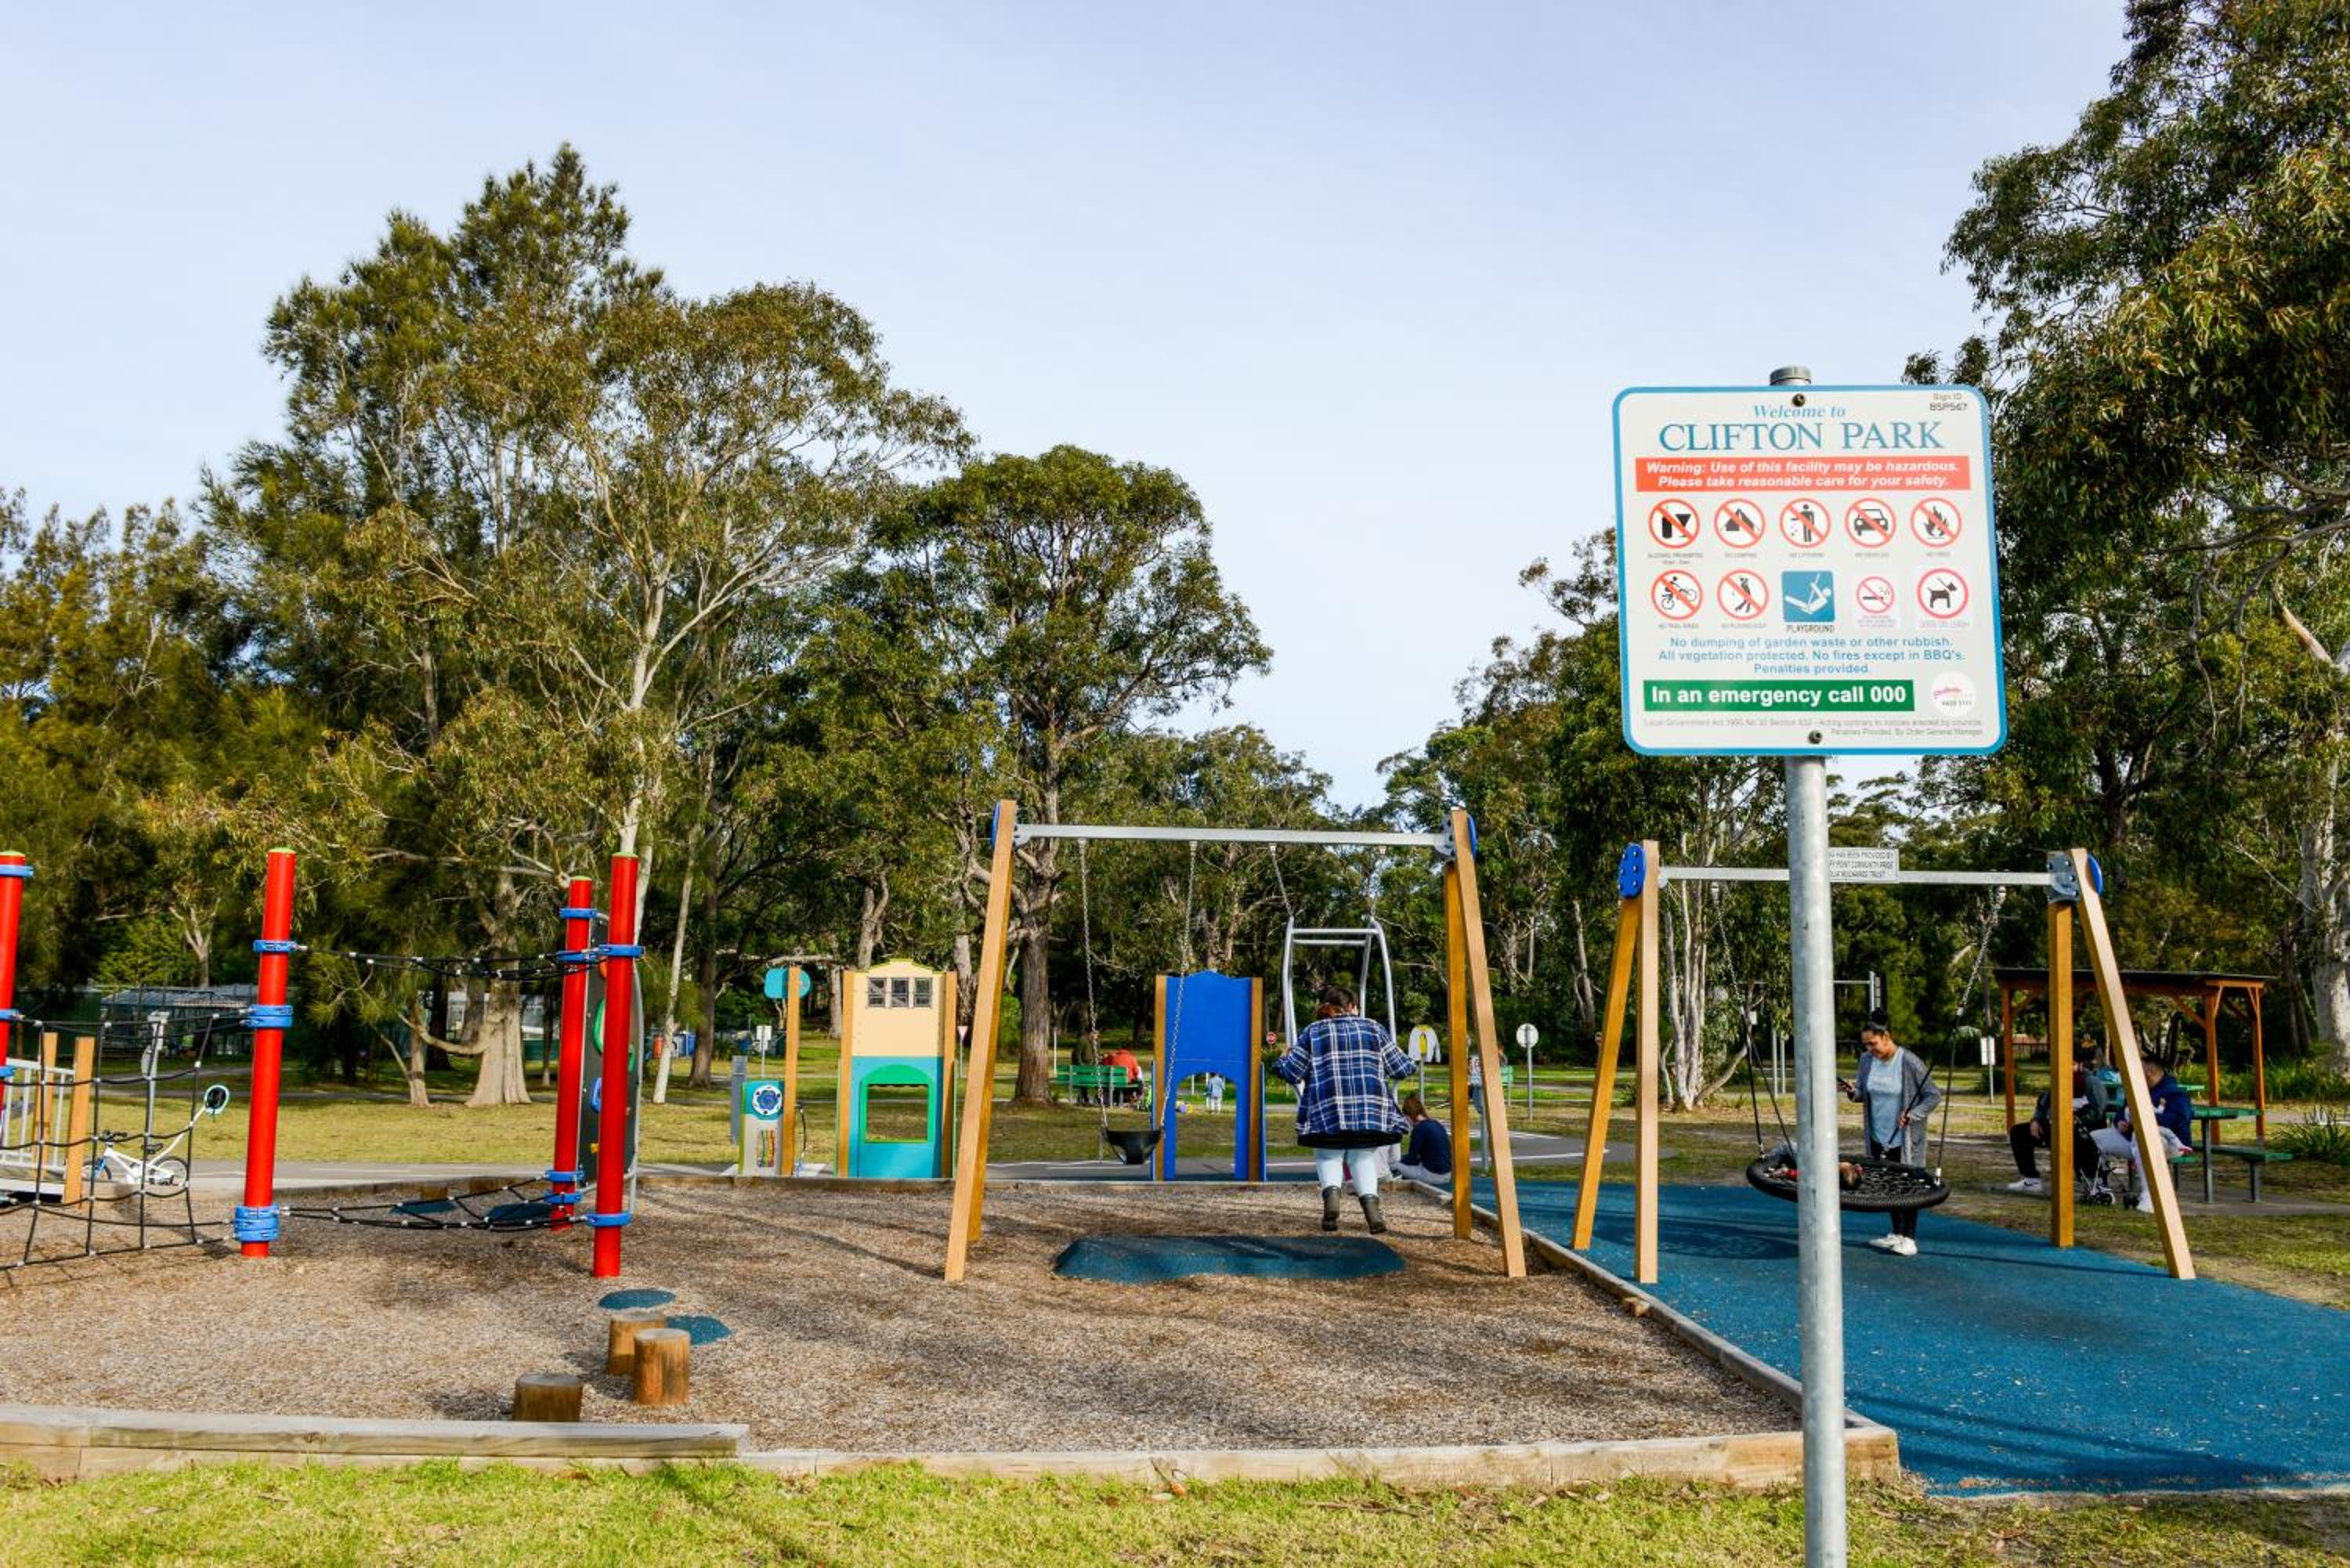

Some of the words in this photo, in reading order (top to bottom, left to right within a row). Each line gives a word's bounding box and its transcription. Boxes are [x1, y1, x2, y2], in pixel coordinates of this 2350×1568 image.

[1754, 404, 1825, 418] Welcome
[1830, 405, 1846, 417] to
[1659, 423, 1823, 451] CLIFTON
[1840, 421, 1944, 449] PARK
[1647, 462, 1706, 475] Warning:
[1712, 462, 1737, 472] Use
[1740, 461, 1755, 472] of
[1757, 461, 1782, 472] this
[1785, 461, 1831, 475] facility
[1835, 462, 1863, 475] may
[1866, 461, 1882, 471] be
[1886, 461, 1958, 471] hazardous.
[1658, 476, 1703, 488] Please
[1707, 476, 1734, 487] take
[1739, 476, 1811, 486] reasonable
[1849, 476, 1867, 486] for
[1871, 478, 1900, 488] your
[1905, 475, 1948, 488] safety.
[1671, 637, 1686, 647] No
[1691, 638, 1744, 649] dumping
[1748, 637, 1761, 647] of
[1765, 638, 1806, 649] garden
[1811, 638, 1846, 647] waste
[1867, 638, 1899, 647] other
[1903, 636, 1954, 647] rubbish.
[1658, 651, 1674, 660] All
[1679, 651, 1742, 663] vegetation
[1746, 651, 1809, 663] protected.
[1813, 651, 1828, 660] No
[1833, 650, 1860, 660] fires
[1864, 651, 1905, 663] except
[1909, 651, 1919, 660] in
[1924, 650, 1965, 661] BBQ's.
[1754, 663, 1810, 674] Penalties
[1652, 687, 1669, 703] In
[1677, 689, 1701, 703] an
[1708, 689, 1824, 706] emergency
[1828, 686, 1864, 703] call
[1870, 687, 1906, 702] 000
